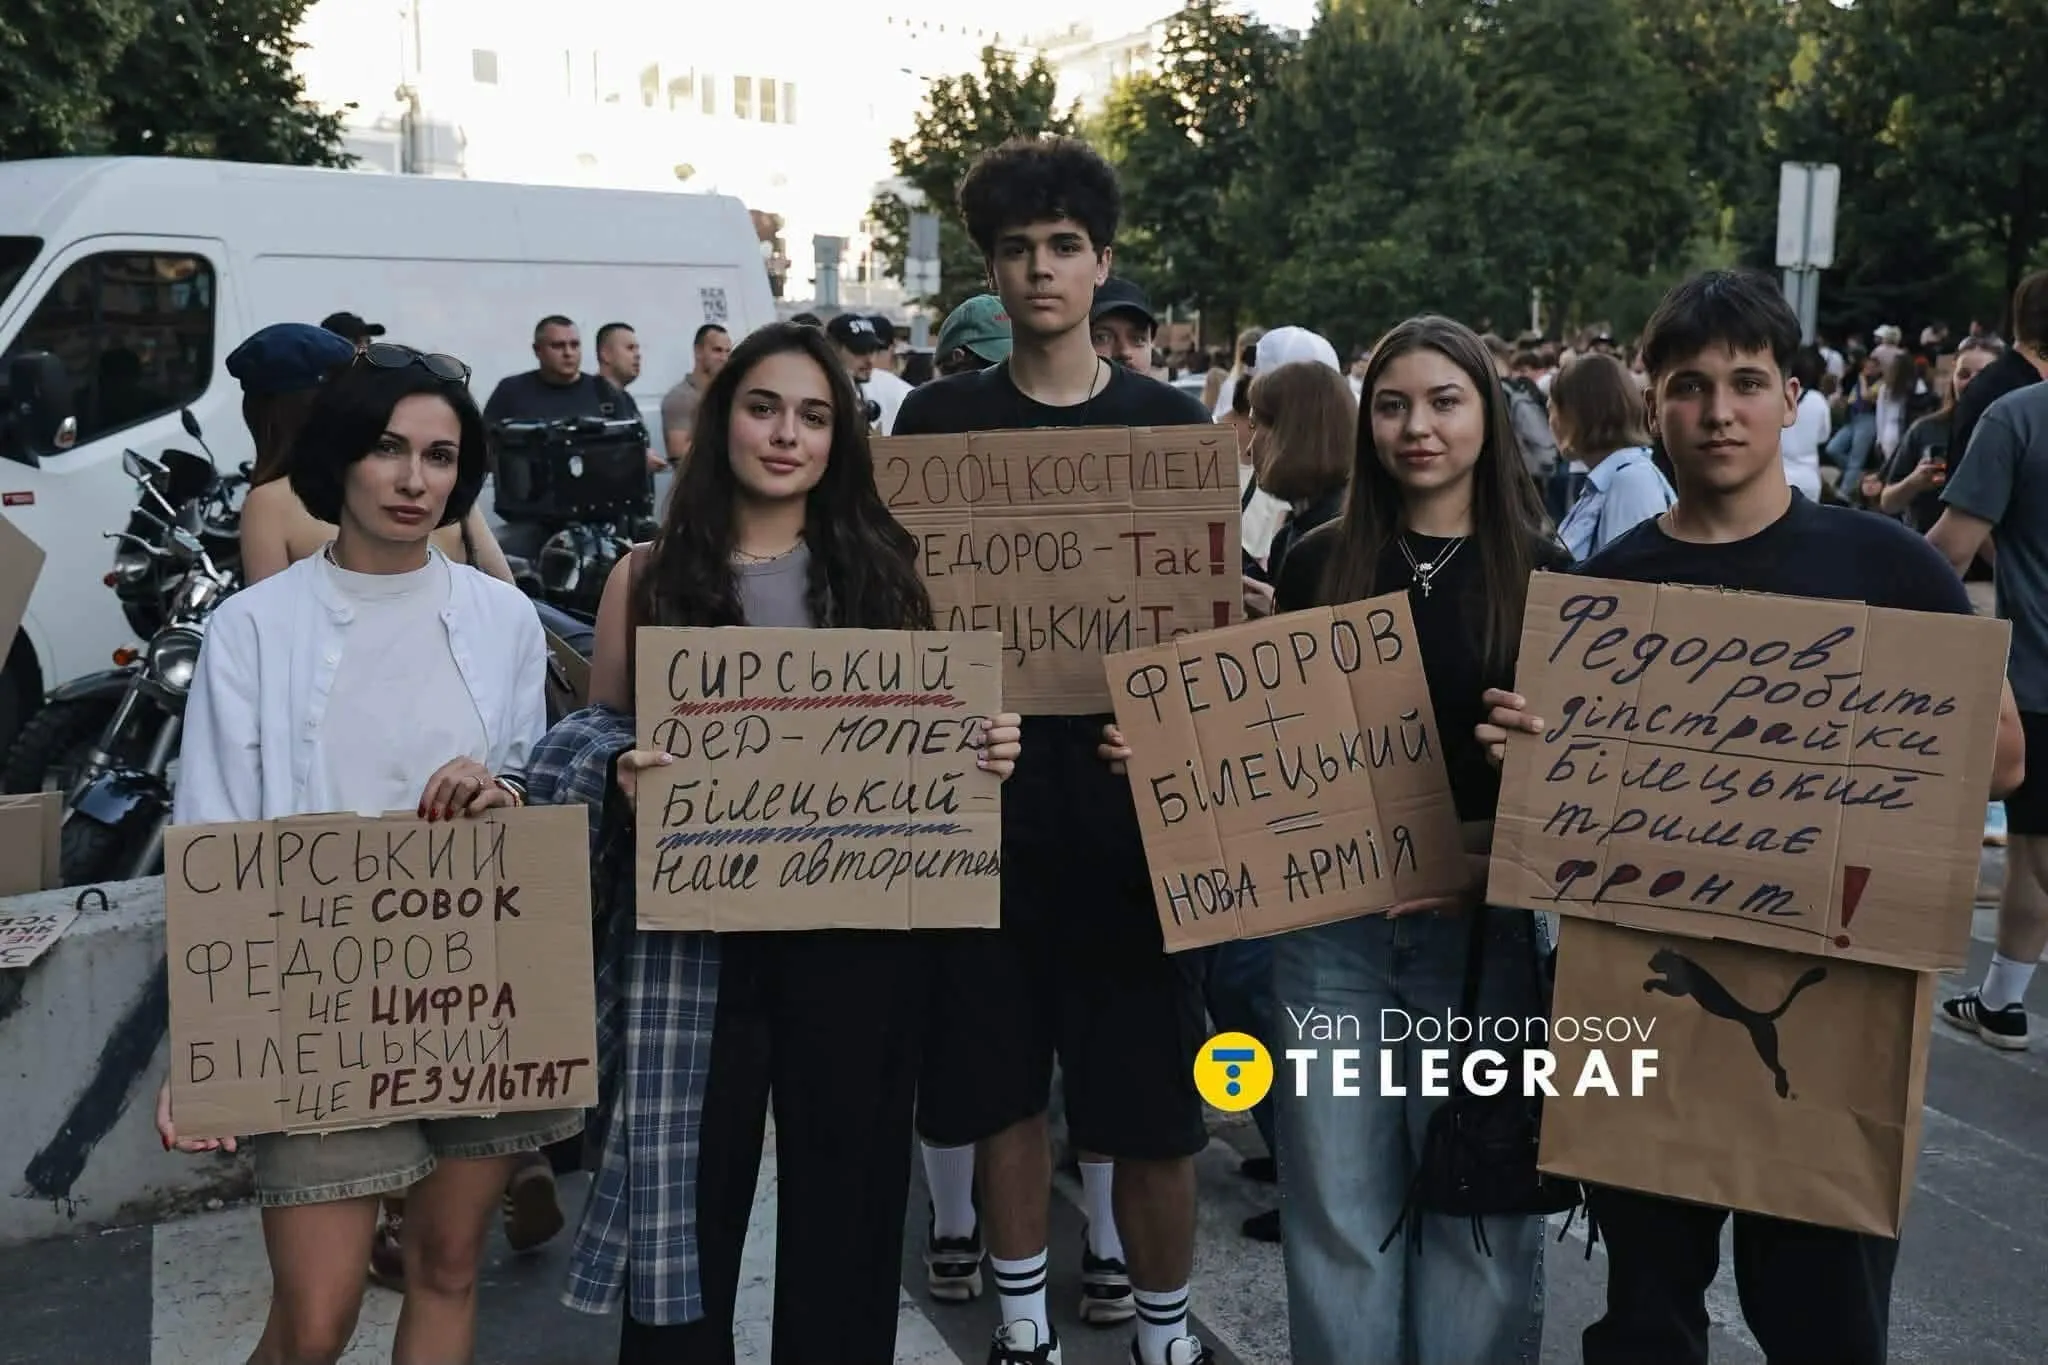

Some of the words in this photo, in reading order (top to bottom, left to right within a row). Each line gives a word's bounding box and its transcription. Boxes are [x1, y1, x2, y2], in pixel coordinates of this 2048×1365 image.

[887, 453, 1012, 506] 2004
[1026, 440, 1222, 501] КОСПЛЕЙ
[1126, 608, 1403, 723] ФЕДОРОВ
[1549, 594, 1855, 685] Федоров
[1545, 695, 1942, 757] діпстрайки
[1714, 672, 1958, 717] робить
[1545, 741, 1918, 809] Білецький
[182, 821, 507, 894] СИРСЬКИЙ
[1543, 801, 1822, 854] тримає
[301, 894, 353, 928] ЦЕ
[373, 886, 521, 922] СОВОК
[1163, 862, 1259, 926] НОВА
[186, 930, 473, 1003] ФЕДОРОВ
[309, 989, 351, 1024] ЦЕ
[372, 983, 516, 1025] ЦИФРА
[190, 1023, 510, 1083] БІЛЕЦЬКИЙ
[369, 1058, 590, 1110] РЕЗУЛЬТАТ
